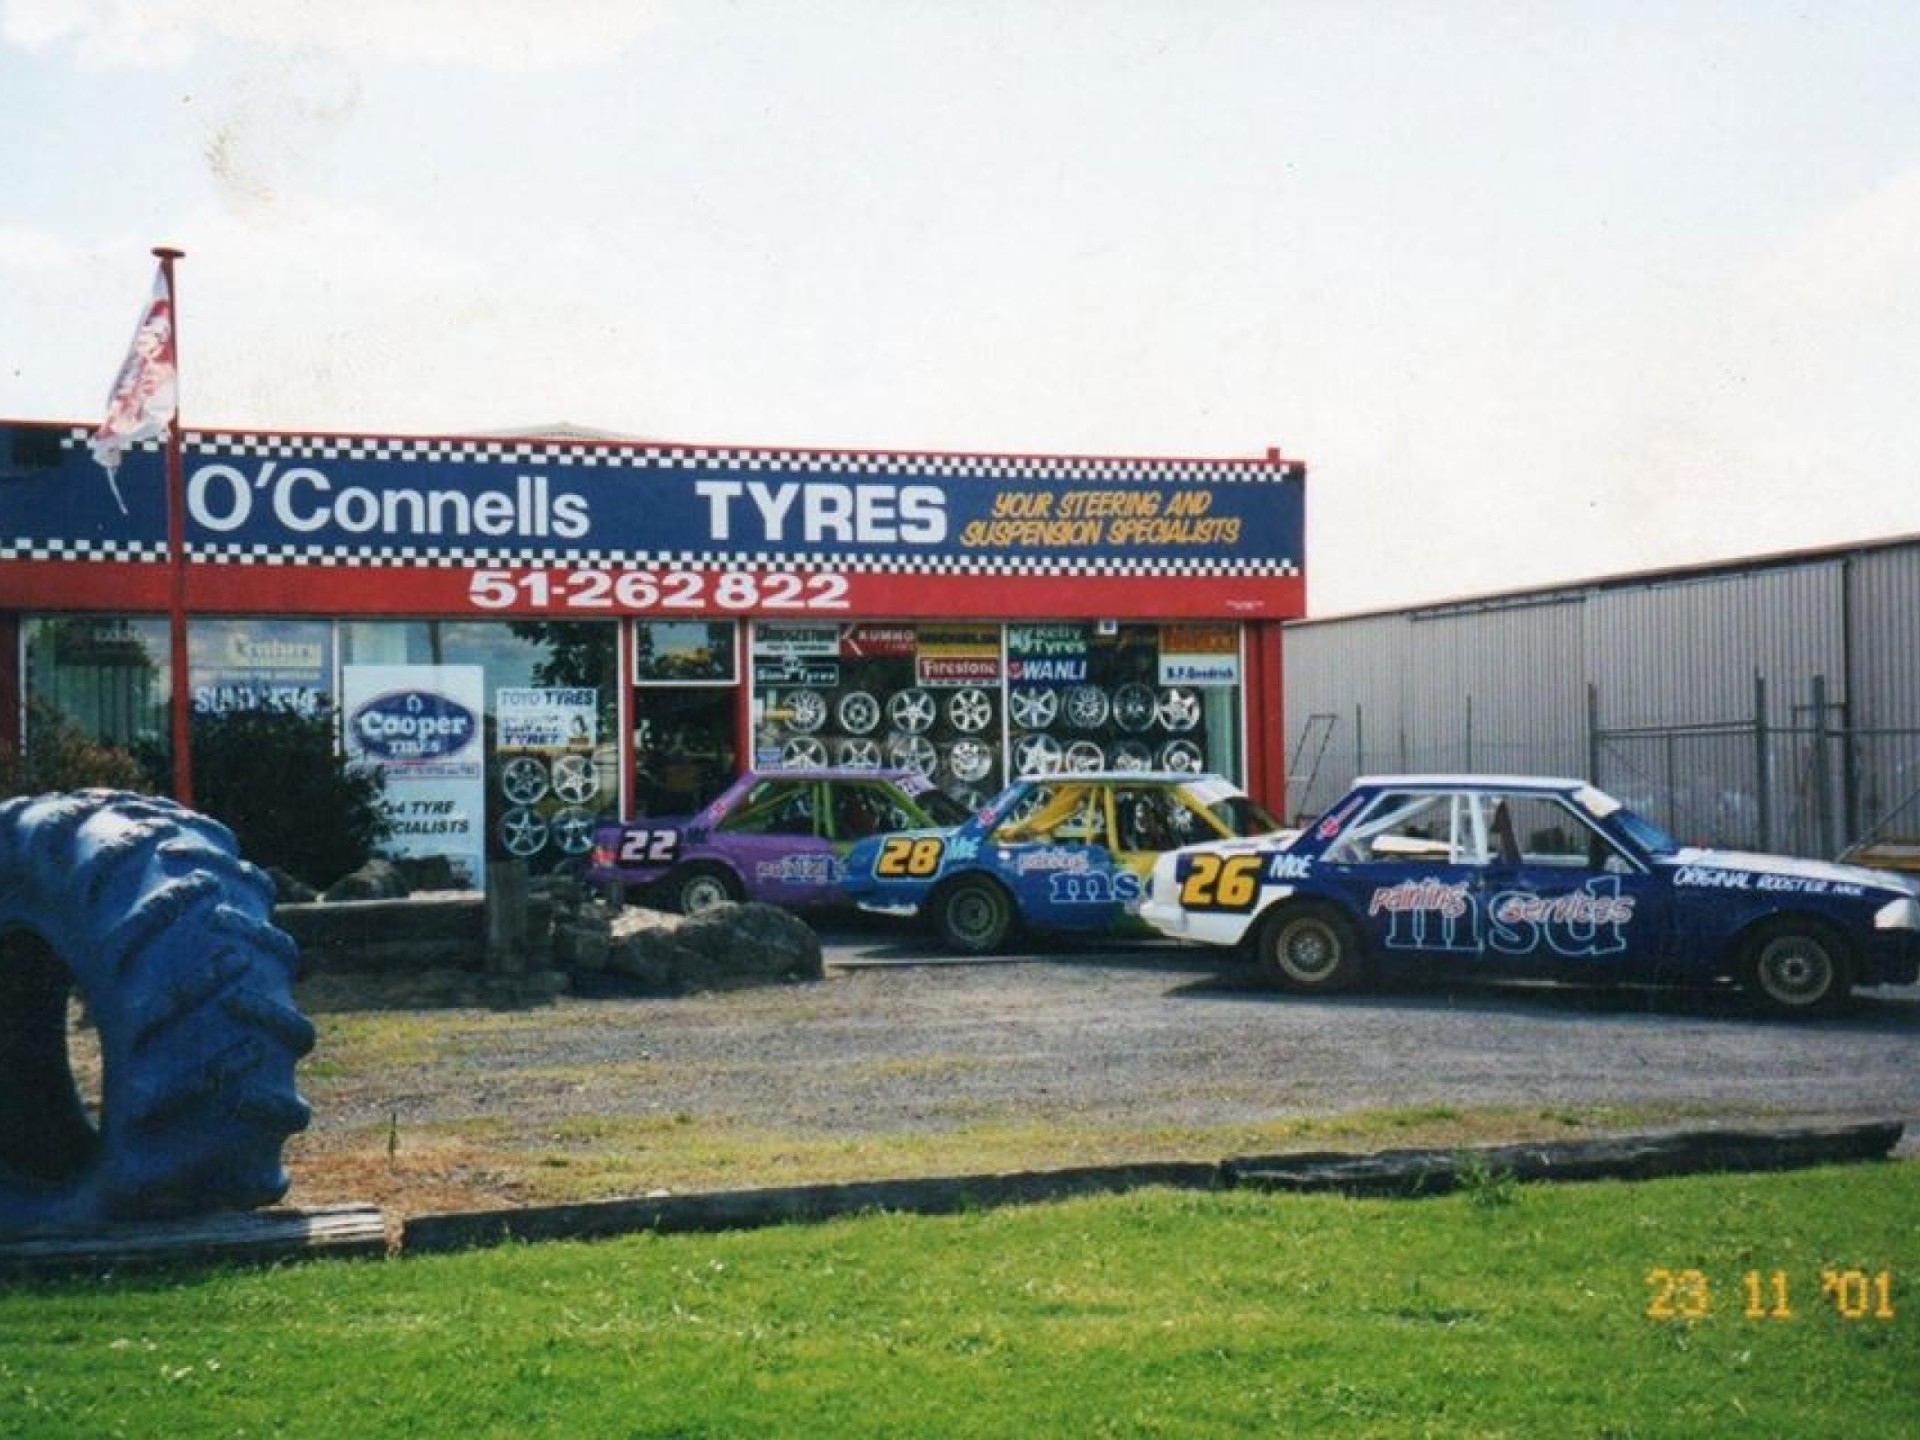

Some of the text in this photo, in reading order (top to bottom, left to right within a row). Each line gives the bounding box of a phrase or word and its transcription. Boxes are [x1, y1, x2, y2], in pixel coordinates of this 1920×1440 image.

[187, 462, 948, 544] O'Connells TYRES
[993, 490, 1213, 518] YOUR STEERING AND
[960, 516, 1241, 546] SUSPENSION SPECIALISTS
[469, 571, 851, 608] 51-262 822
[1036, 626, 1082, 641] Kelly
[922, 658, 997, 678] Firestone
[1022, 659, 1087, 680] WANLI
[545, 690, 593, 705] TYRES
[361, 710, 467, 739] Cooper
[411, 800, 456, 815] TYRE
[620, 830, 677, 861] 22
[877, 837, 942, 876] 28
[1050, 870, 1152, 904] ms
[1181, 855, 1263, 907] 26
[1673, 865, 1751, 889] ORIGINAL
